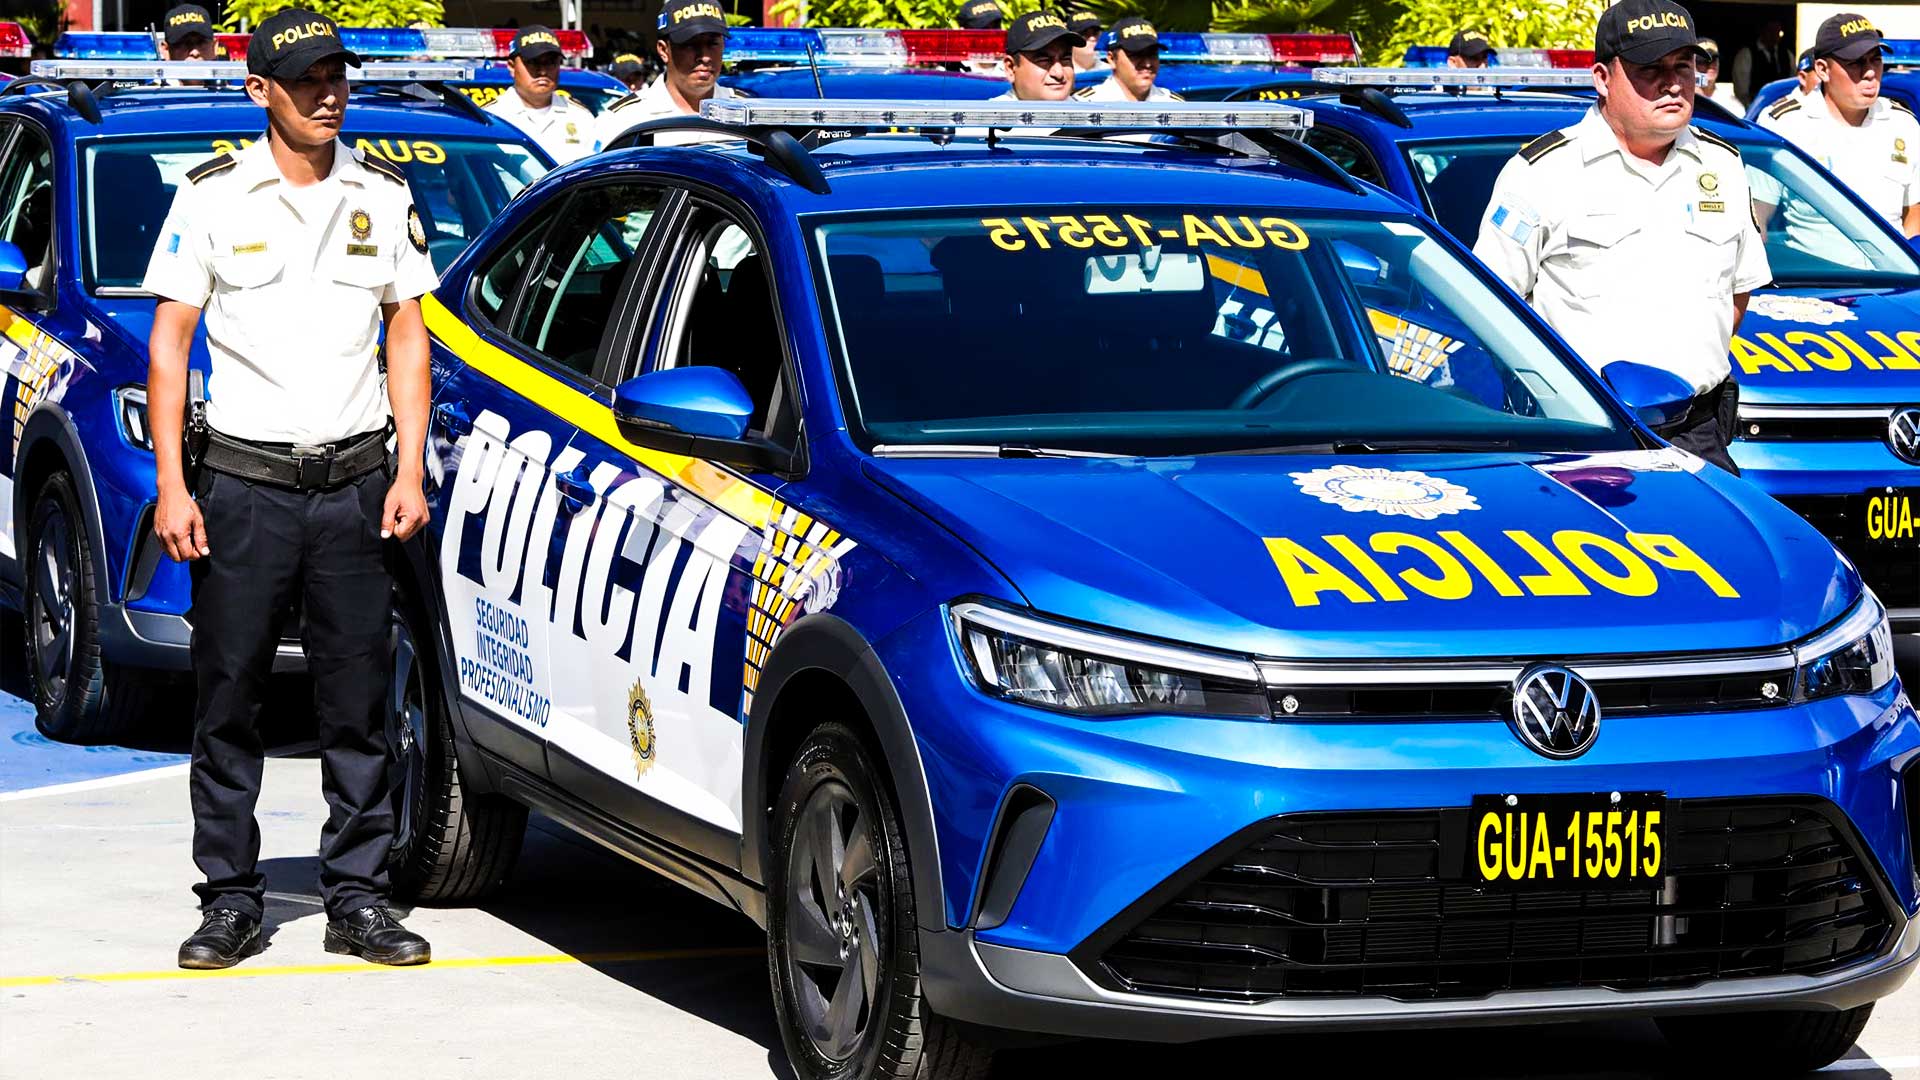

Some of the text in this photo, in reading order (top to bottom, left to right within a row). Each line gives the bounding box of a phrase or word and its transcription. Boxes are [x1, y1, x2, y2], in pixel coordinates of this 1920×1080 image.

[170, 12, 205, 27] POLICIA
[673, 4, 722, 24] POLICIA
[1627, 12, 1689, 34] POLICIA
[272, 21, 335, 51] POLICIA
[817, 130, 852, 139] Abrams
[440, 408, 750, 714] POLICIA
[476, 597, 528, 649] SEGURIDAD
[476, 630, 533, 684] INTEGRIDAD
[461, 656, 550, 728] PROFESIONALISMO
[1477, 811, 1662, 881] GUA-15515
